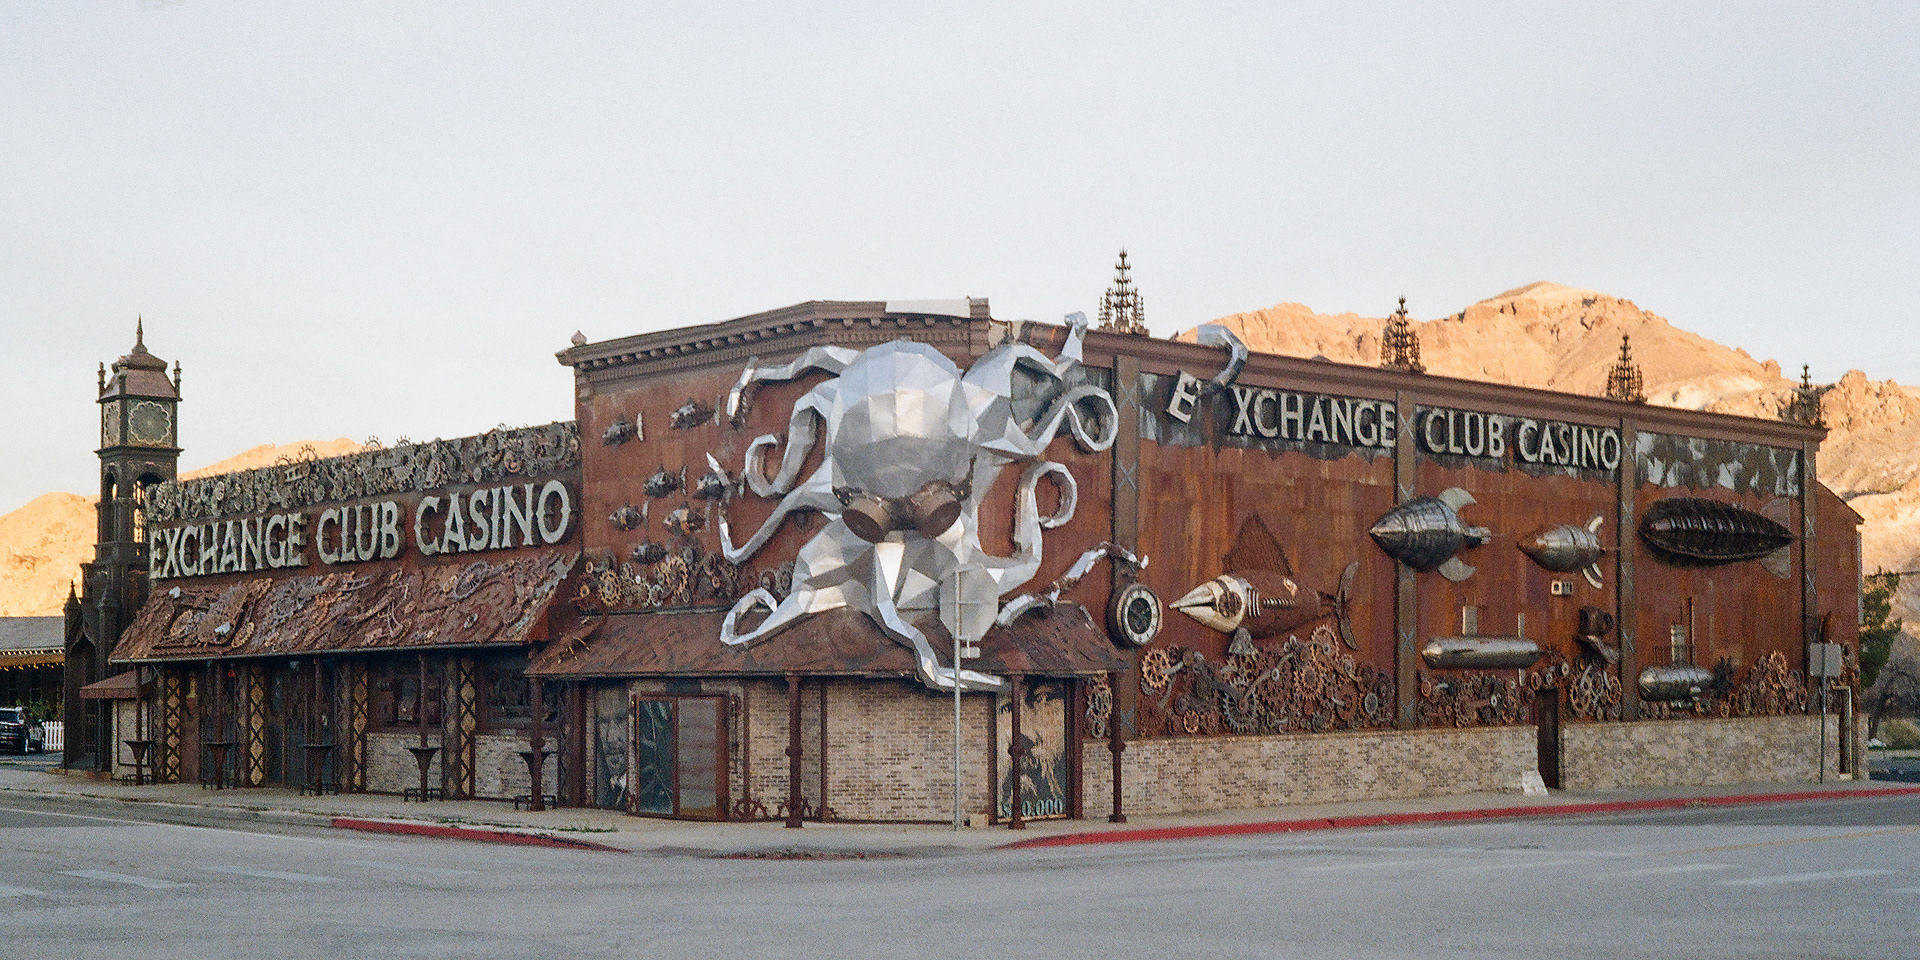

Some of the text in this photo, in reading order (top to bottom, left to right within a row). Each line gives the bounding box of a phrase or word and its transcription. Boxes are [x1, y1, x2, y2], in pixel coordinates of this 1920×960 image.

[1425, 407, 1505, 458] CLUB
[1518, 418, 1621, 471] CASINO
[149, 479, 572, 580] EXCHANGE CLUB CASINO
